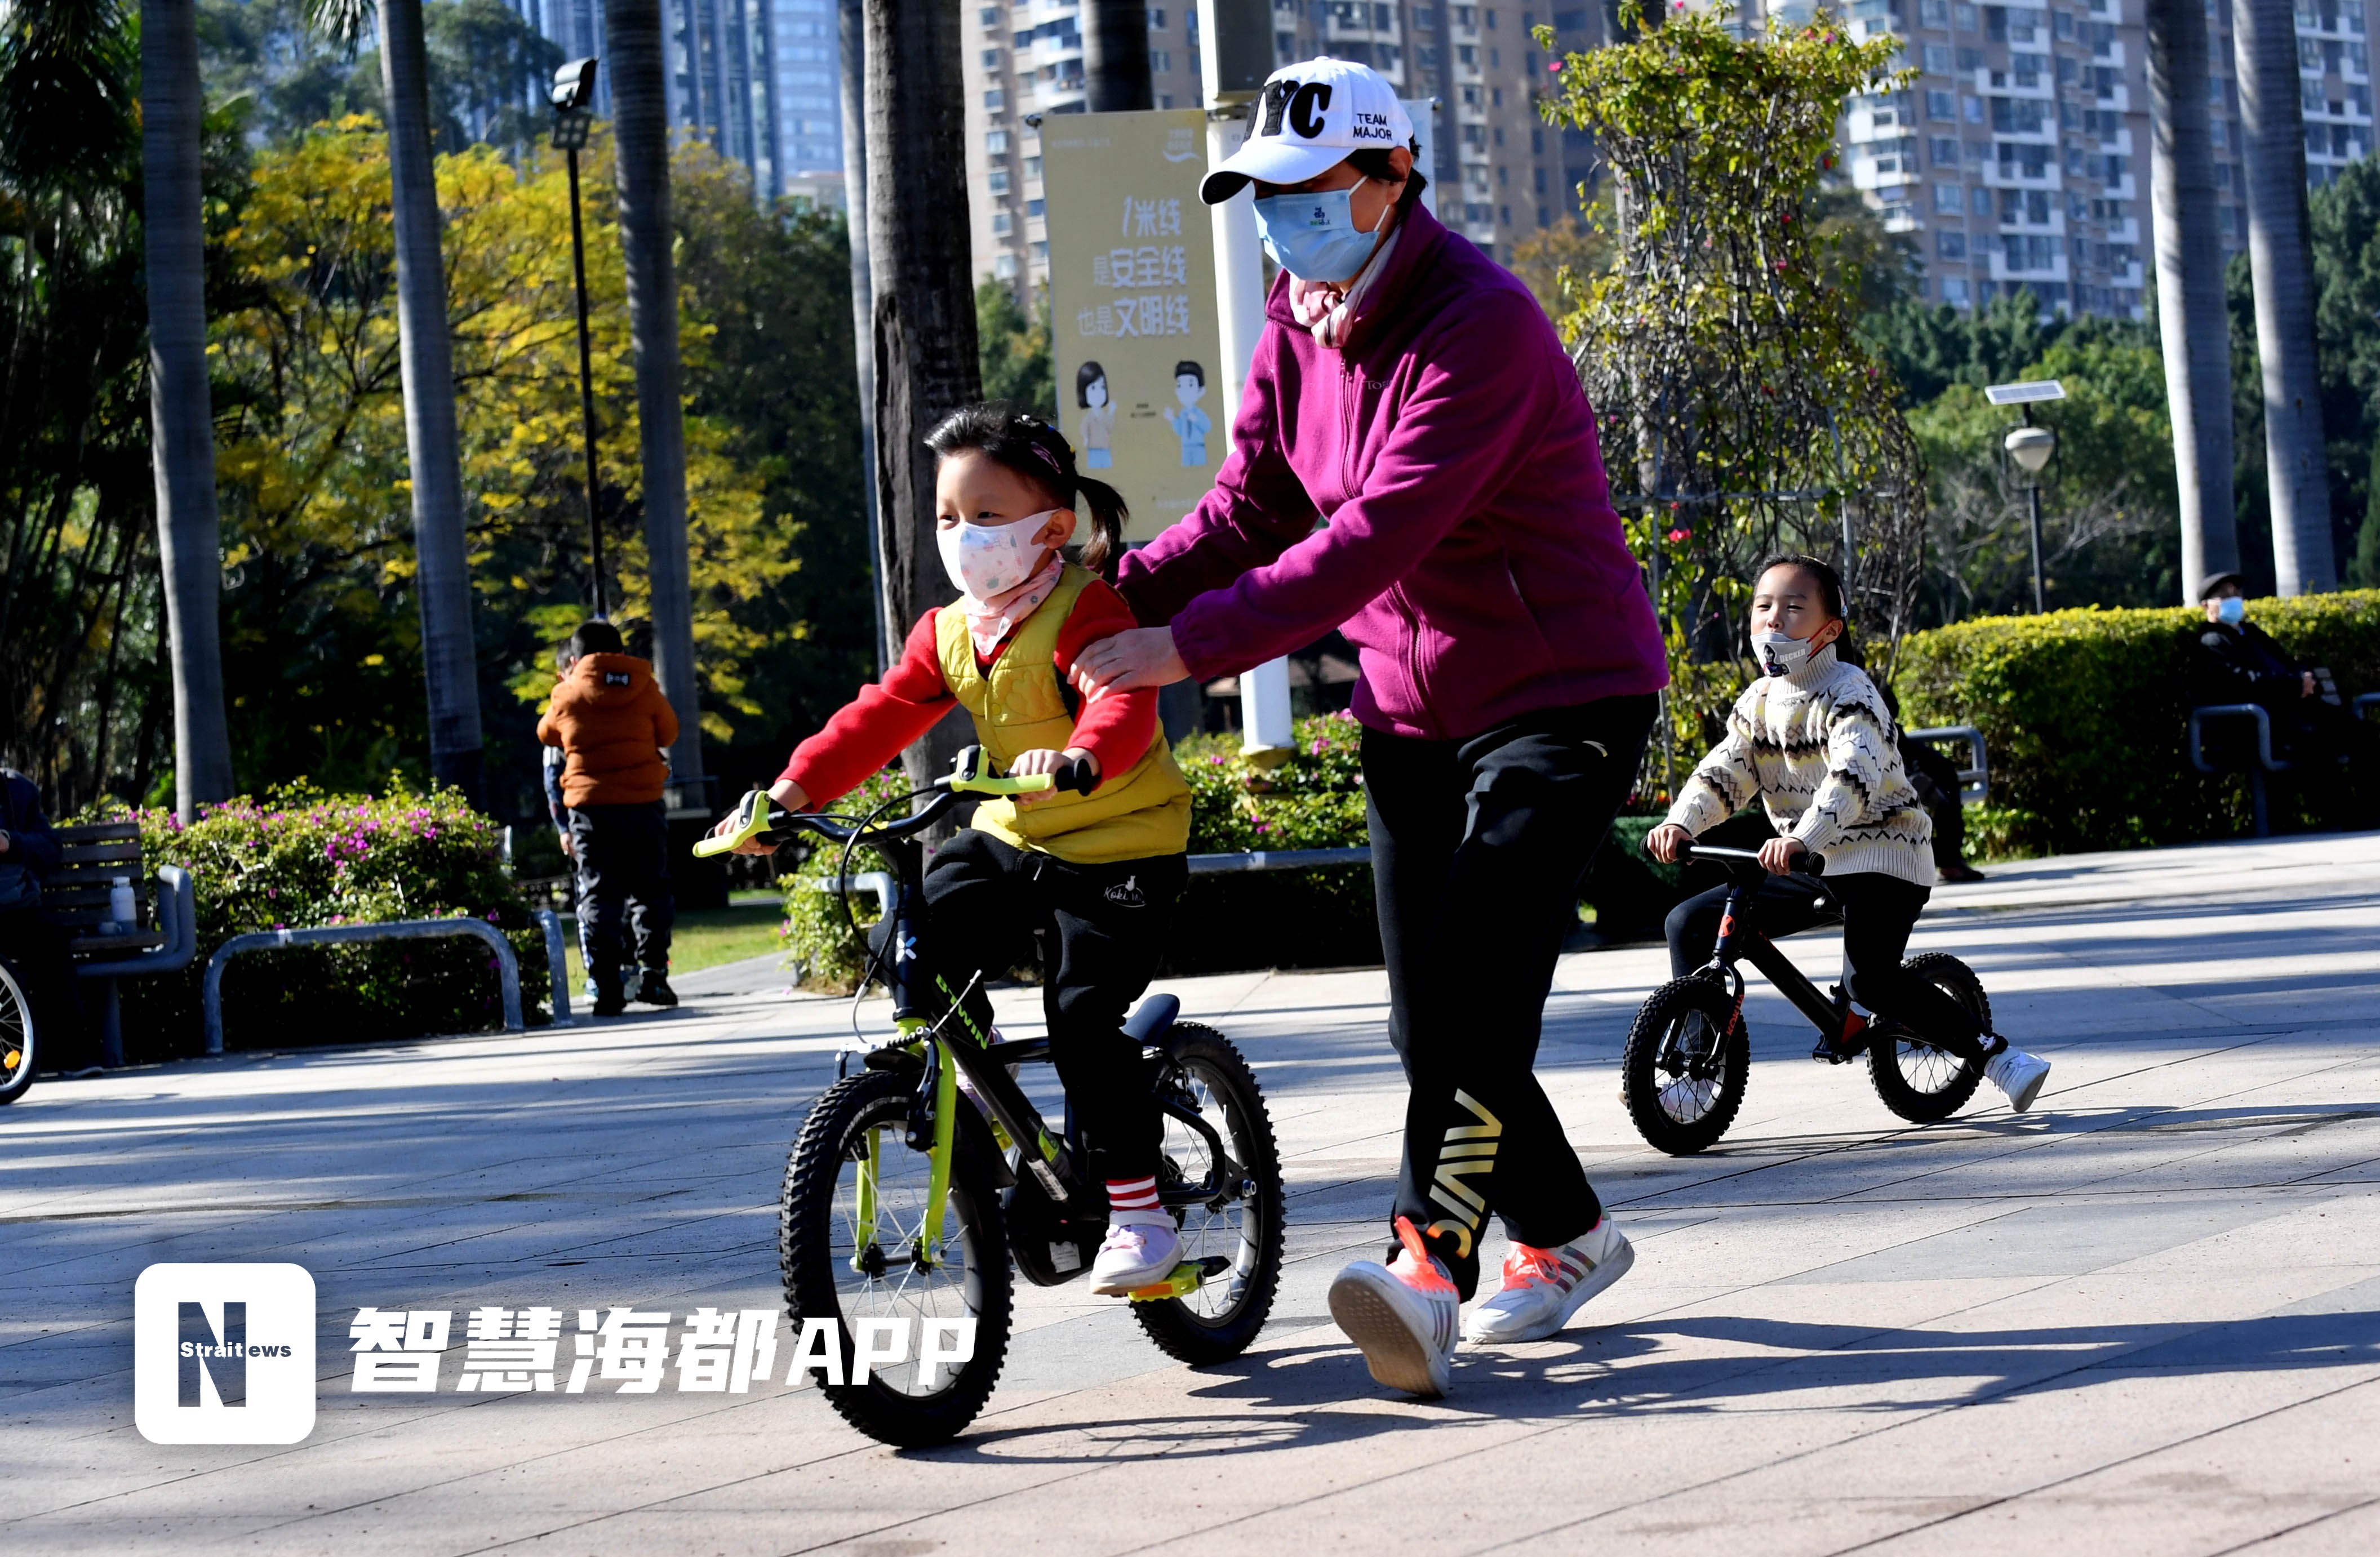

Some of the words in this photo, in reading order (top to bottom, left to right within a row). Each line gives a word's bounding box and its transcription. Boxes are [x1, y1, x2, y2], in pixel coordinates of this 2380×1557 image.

[1353, 126, 1392, 141] MAJOR
[1356, 113, 1387, 126] TEAM
[1122, 194, 1181, 237] 1米线
[1094, 245, 1187, 288] 是安全线
[1077, 293, 1191, 337] 也是文明线
[1779, 648, 1806, 663] DECKER
